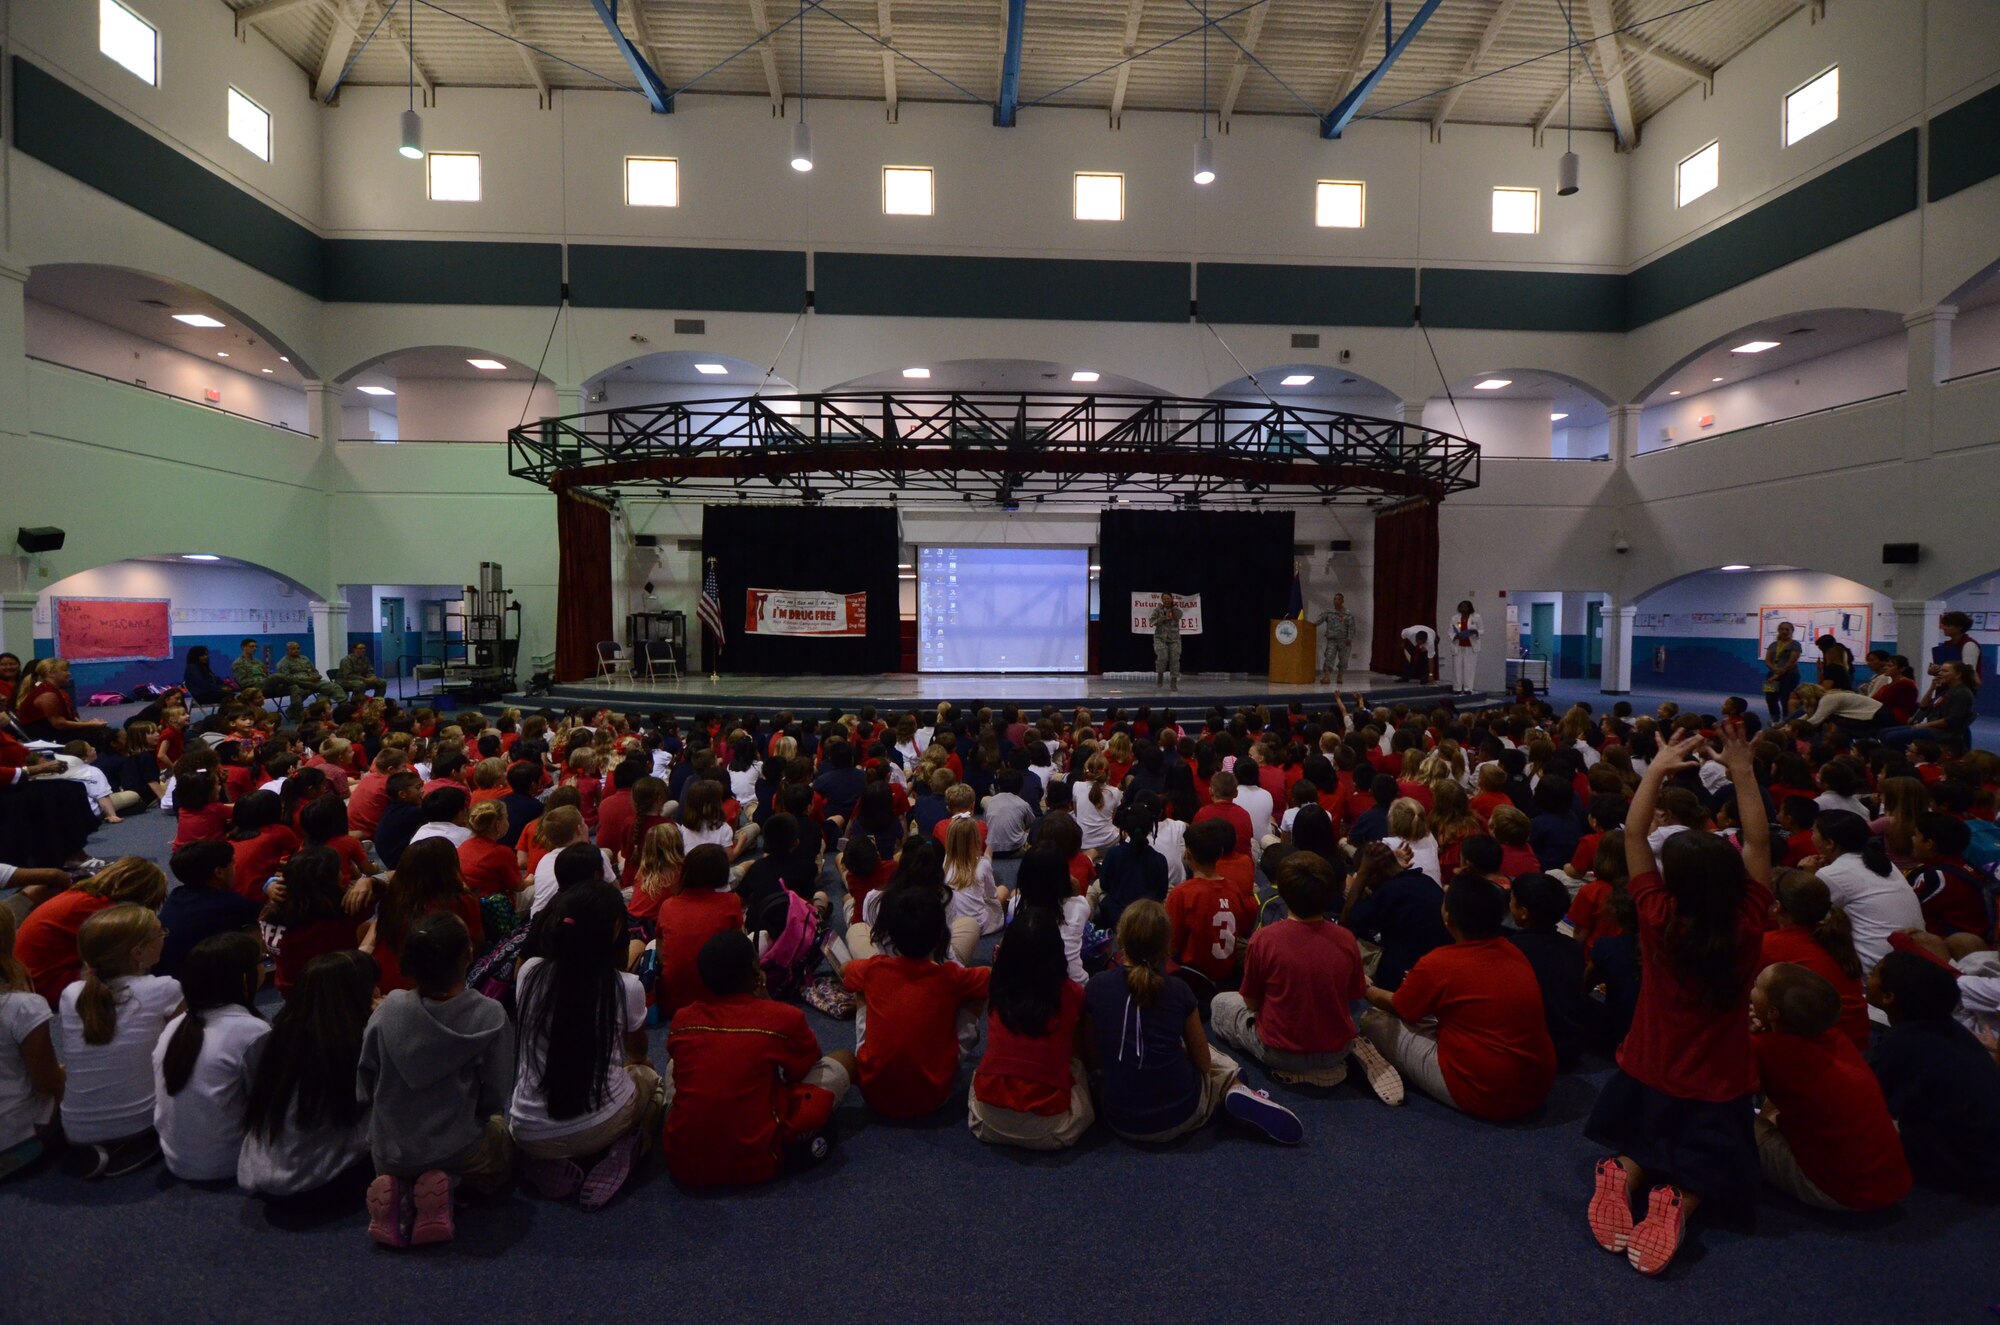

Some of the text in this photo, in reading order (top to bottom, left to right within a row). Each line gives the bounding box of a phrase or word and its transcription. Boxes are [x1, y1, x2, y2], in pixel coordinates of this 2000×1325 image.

[772, 606, 836, 621] I'M DRUG FREE
[1219, 898, 1230, 909] N
[1211, 911, 1236, 960] 3
